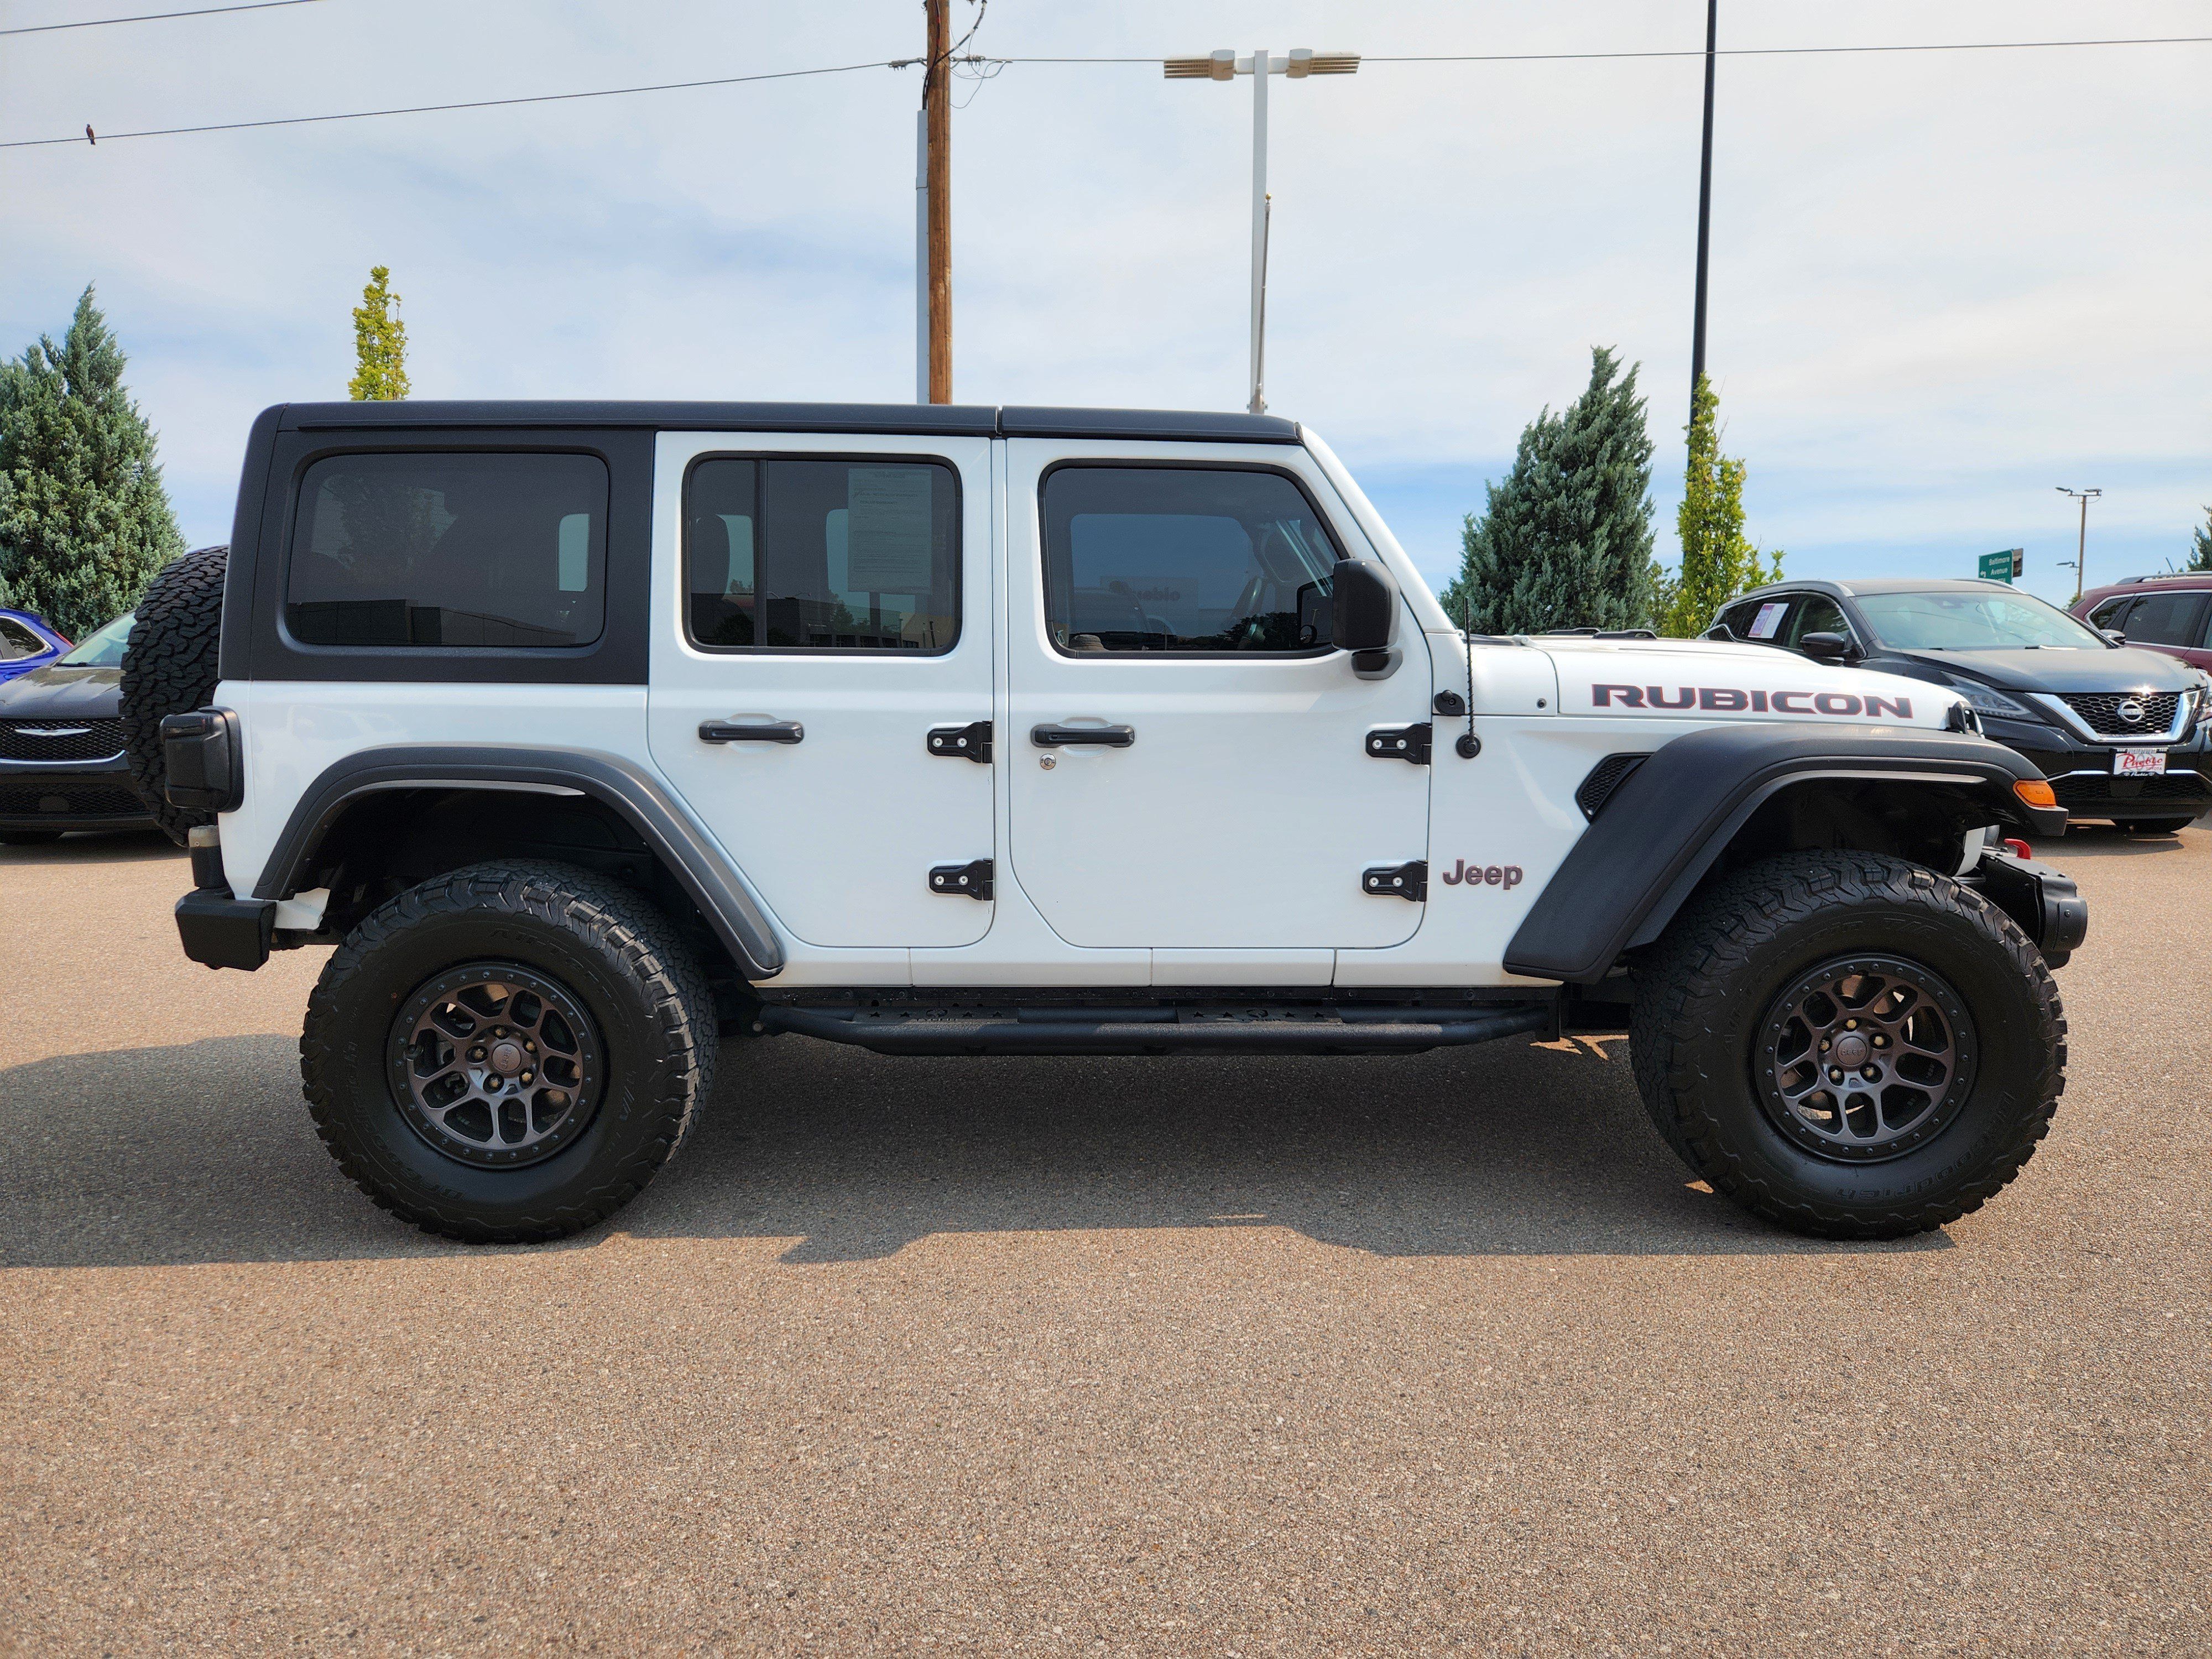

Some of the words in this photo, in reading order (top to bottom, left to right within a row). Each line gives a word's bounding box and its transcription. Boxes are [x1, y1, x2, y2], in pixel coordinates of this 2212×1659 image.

[1591, 684, 1913, 718] RUBICON
[2116, 753, 2163, 768] Pueblo
[1442, 859, 1523, 890] Jeep
